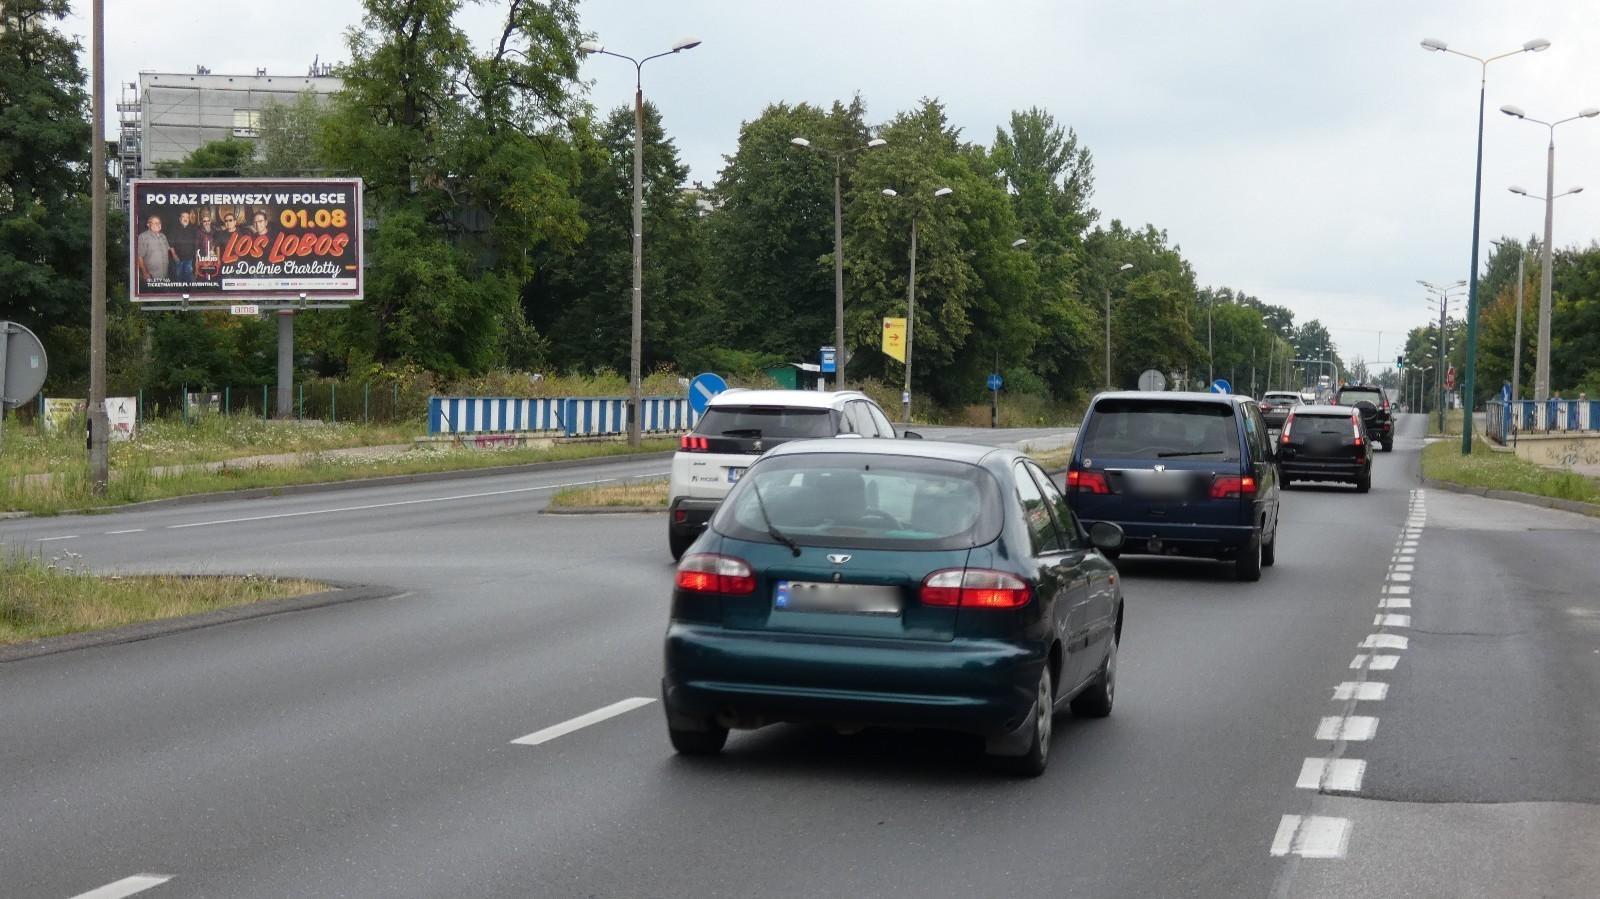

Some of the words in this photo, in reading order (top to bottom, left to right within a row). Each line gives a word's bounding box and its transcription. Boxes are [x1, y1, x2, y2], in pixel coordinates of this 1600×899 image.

[146, 193, 167, 205] PO
[169, 193, 198, 205] RAZ
[200, 193, 272, 205] PIERWSZY
[274, 193, 290, 205] W
[292, 193, 346, 205] POLSCE
[280, 208, 347, 229] 01.08
[221, 232, 270, 263] LOS
[268, 231, 349, 263] LOBOS
[221, 265, 235, 275] w
[235, 260, 282, 275] Dolinie
[283, 260, 341, 278] Charlotty
